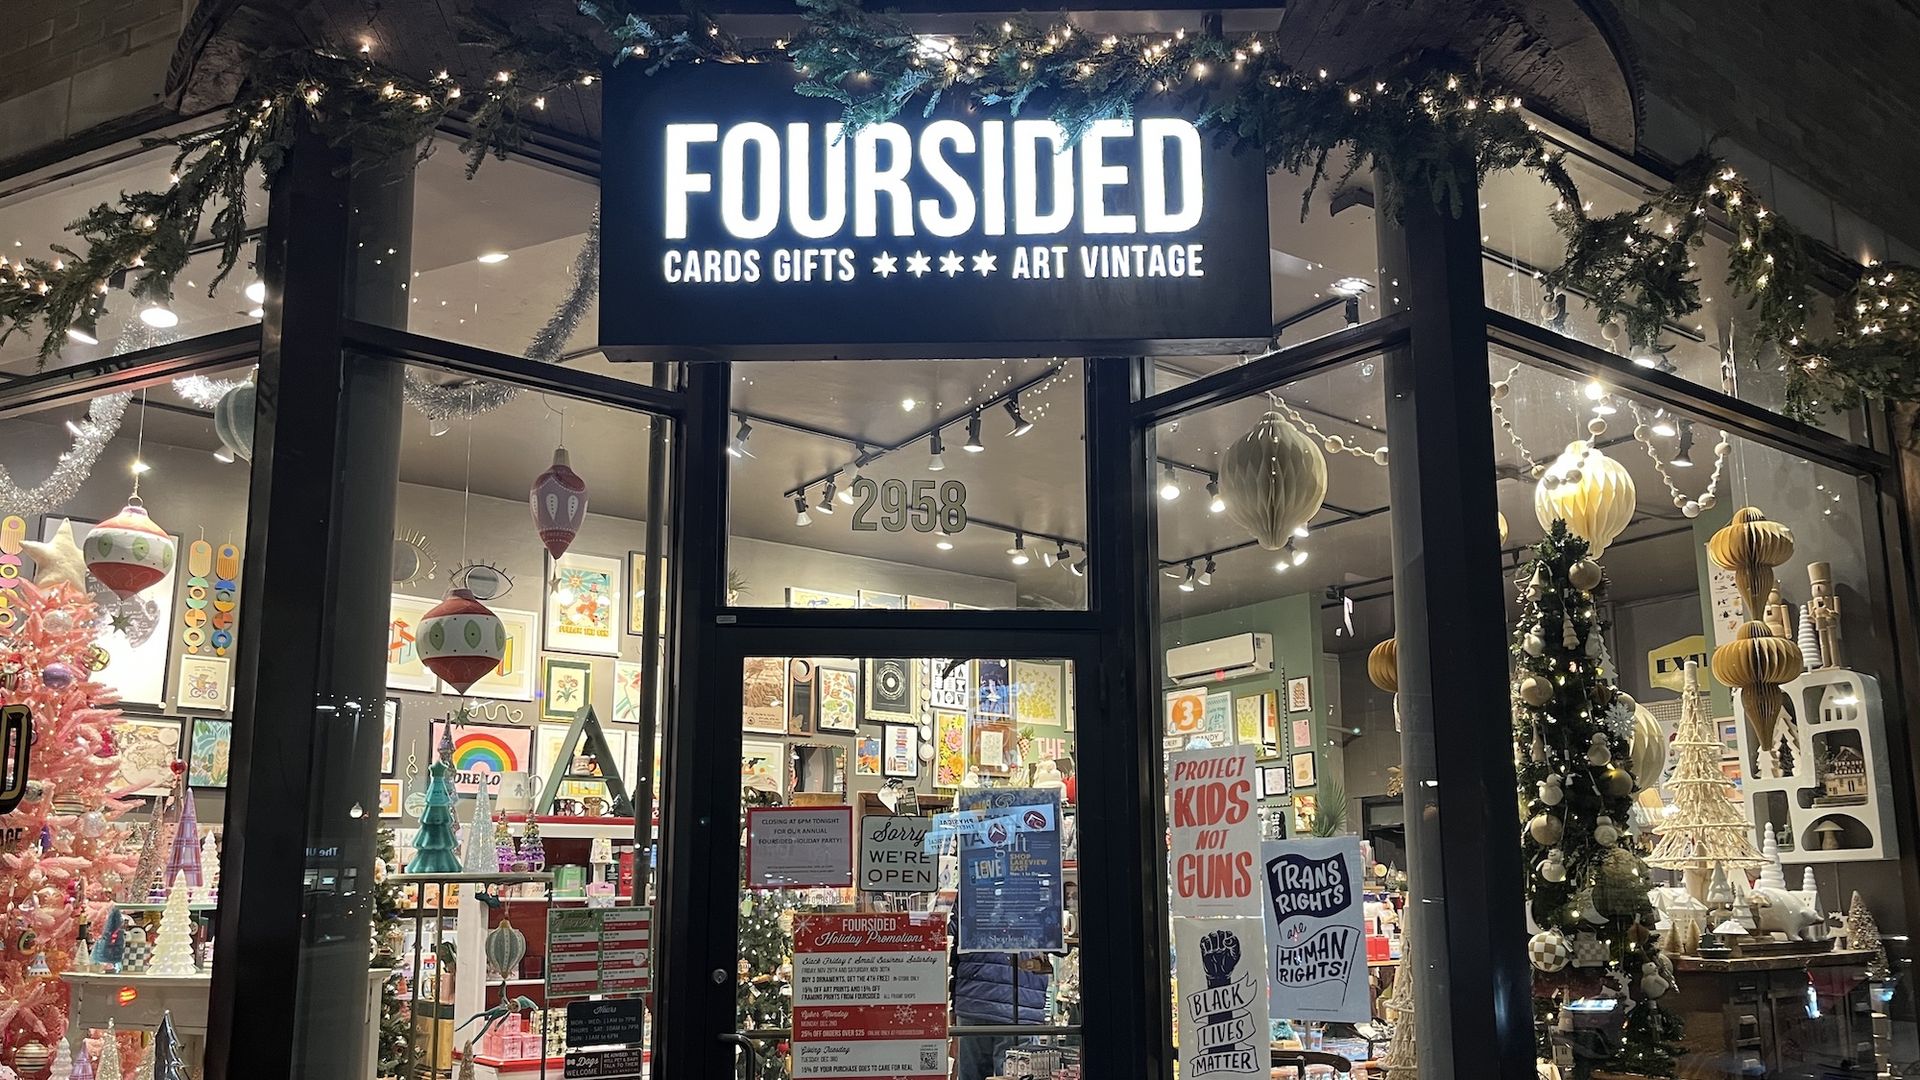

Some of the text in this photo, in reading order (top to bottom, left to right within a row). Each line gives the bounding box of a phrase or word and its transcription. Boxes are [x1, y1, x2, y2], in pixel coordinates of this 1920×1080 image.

[664, 117, 1204, 239] FOURSIDED
[664, 243, 1205, 283] CARDS GIFTS ART VINTAGE
[852, 478, 968, 533] 2958
[453, 772, 480, 785] ORE
[1174, 756, 1246, 782] PROTECT
[1174, 779, 1251, 828] KIDS
[869, 821, 928, 847] Sorry
[1195, 829, 1230, 850] NOT
[869, 850, 931, 864] WE'RE
[975, 859, 1003, 879] LOVE
[868, 869, 931, 883] OPEN
[1177, 851, 1253, 899] GUNS
[1272, 859, 1342, 892] TRANS
[1276, 884, 1344, 915] RIGHTS
[842, 918, 897, 932] FOURSIDED
[815, 930, 923, 947] Holiday Promotions
[1280, 929, 1349, 966] HUMAN
[1279, 961, 1348, 983] RIGHTS!
[1193, 985, 1245, 1016] BLACK
[1201, 1019, 1244, 1046] LIVES
[566, 1068, 598, 1077] WELCOME
[576, 1056, 599, 1067] Dogs
[1195, 1051, 1251, 1074] MATTER
